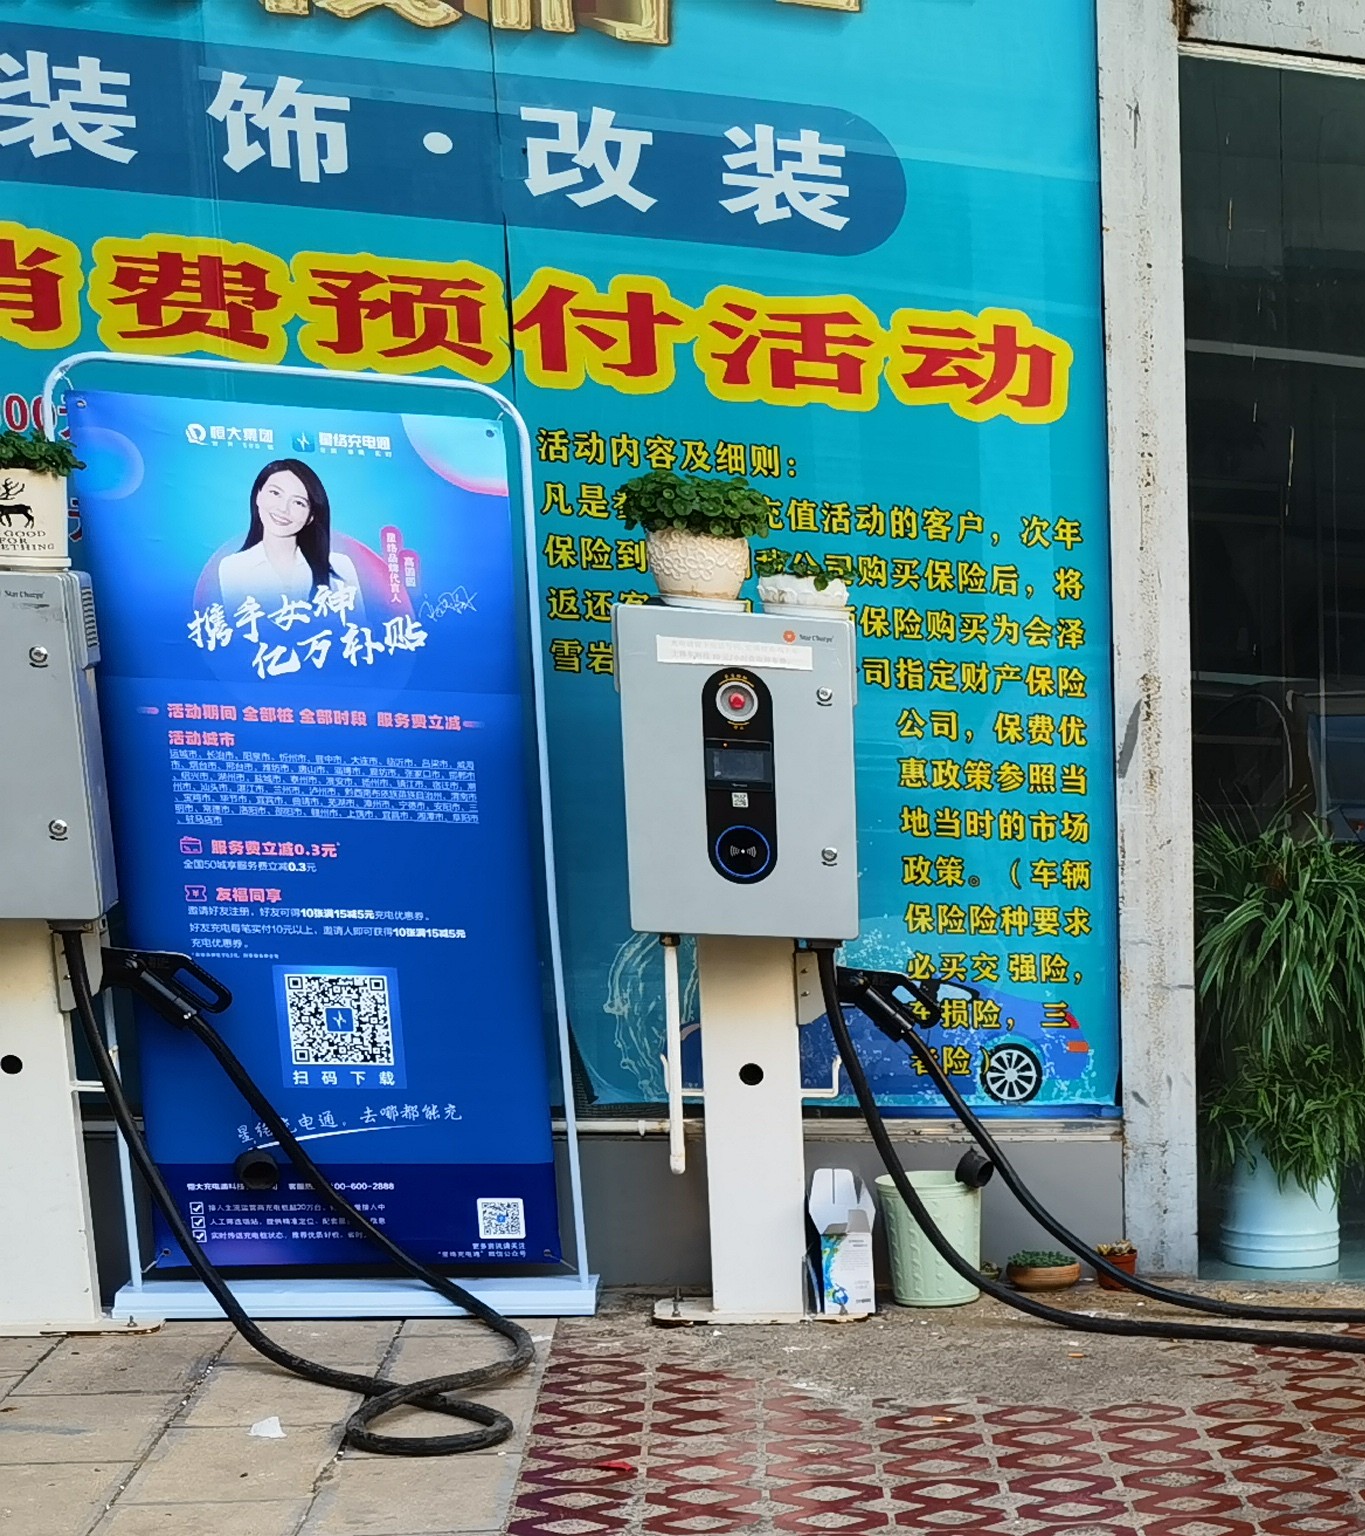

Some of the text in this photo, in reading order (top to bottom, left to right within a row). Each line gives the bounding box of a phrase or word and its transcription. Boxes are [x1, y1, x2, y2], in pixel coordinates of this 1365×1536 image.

[537, 428, 797, 478] 活动内容及细则：
[844, 606, 1086, 650] 保险购买为会泽
[252, 614, 429, 680] 亿万补贴
[167, 703, 237, 722] 活动期间
[377, 711, 462, 732] 服务费立减
[897, 709, 1088, 746] 公司，保费优
[168, 730, 235, 748] 活动城市
[898, 757, 1088, 796] 惠政策参照当
[900, 807, 1090, 843] 地当时的市场
[904, 902, 1091, 937] 保险险种要求
[293, 1069, 395, 1086] 扫码下载
[332, 1182, 395, 1191] 00-600-2888
